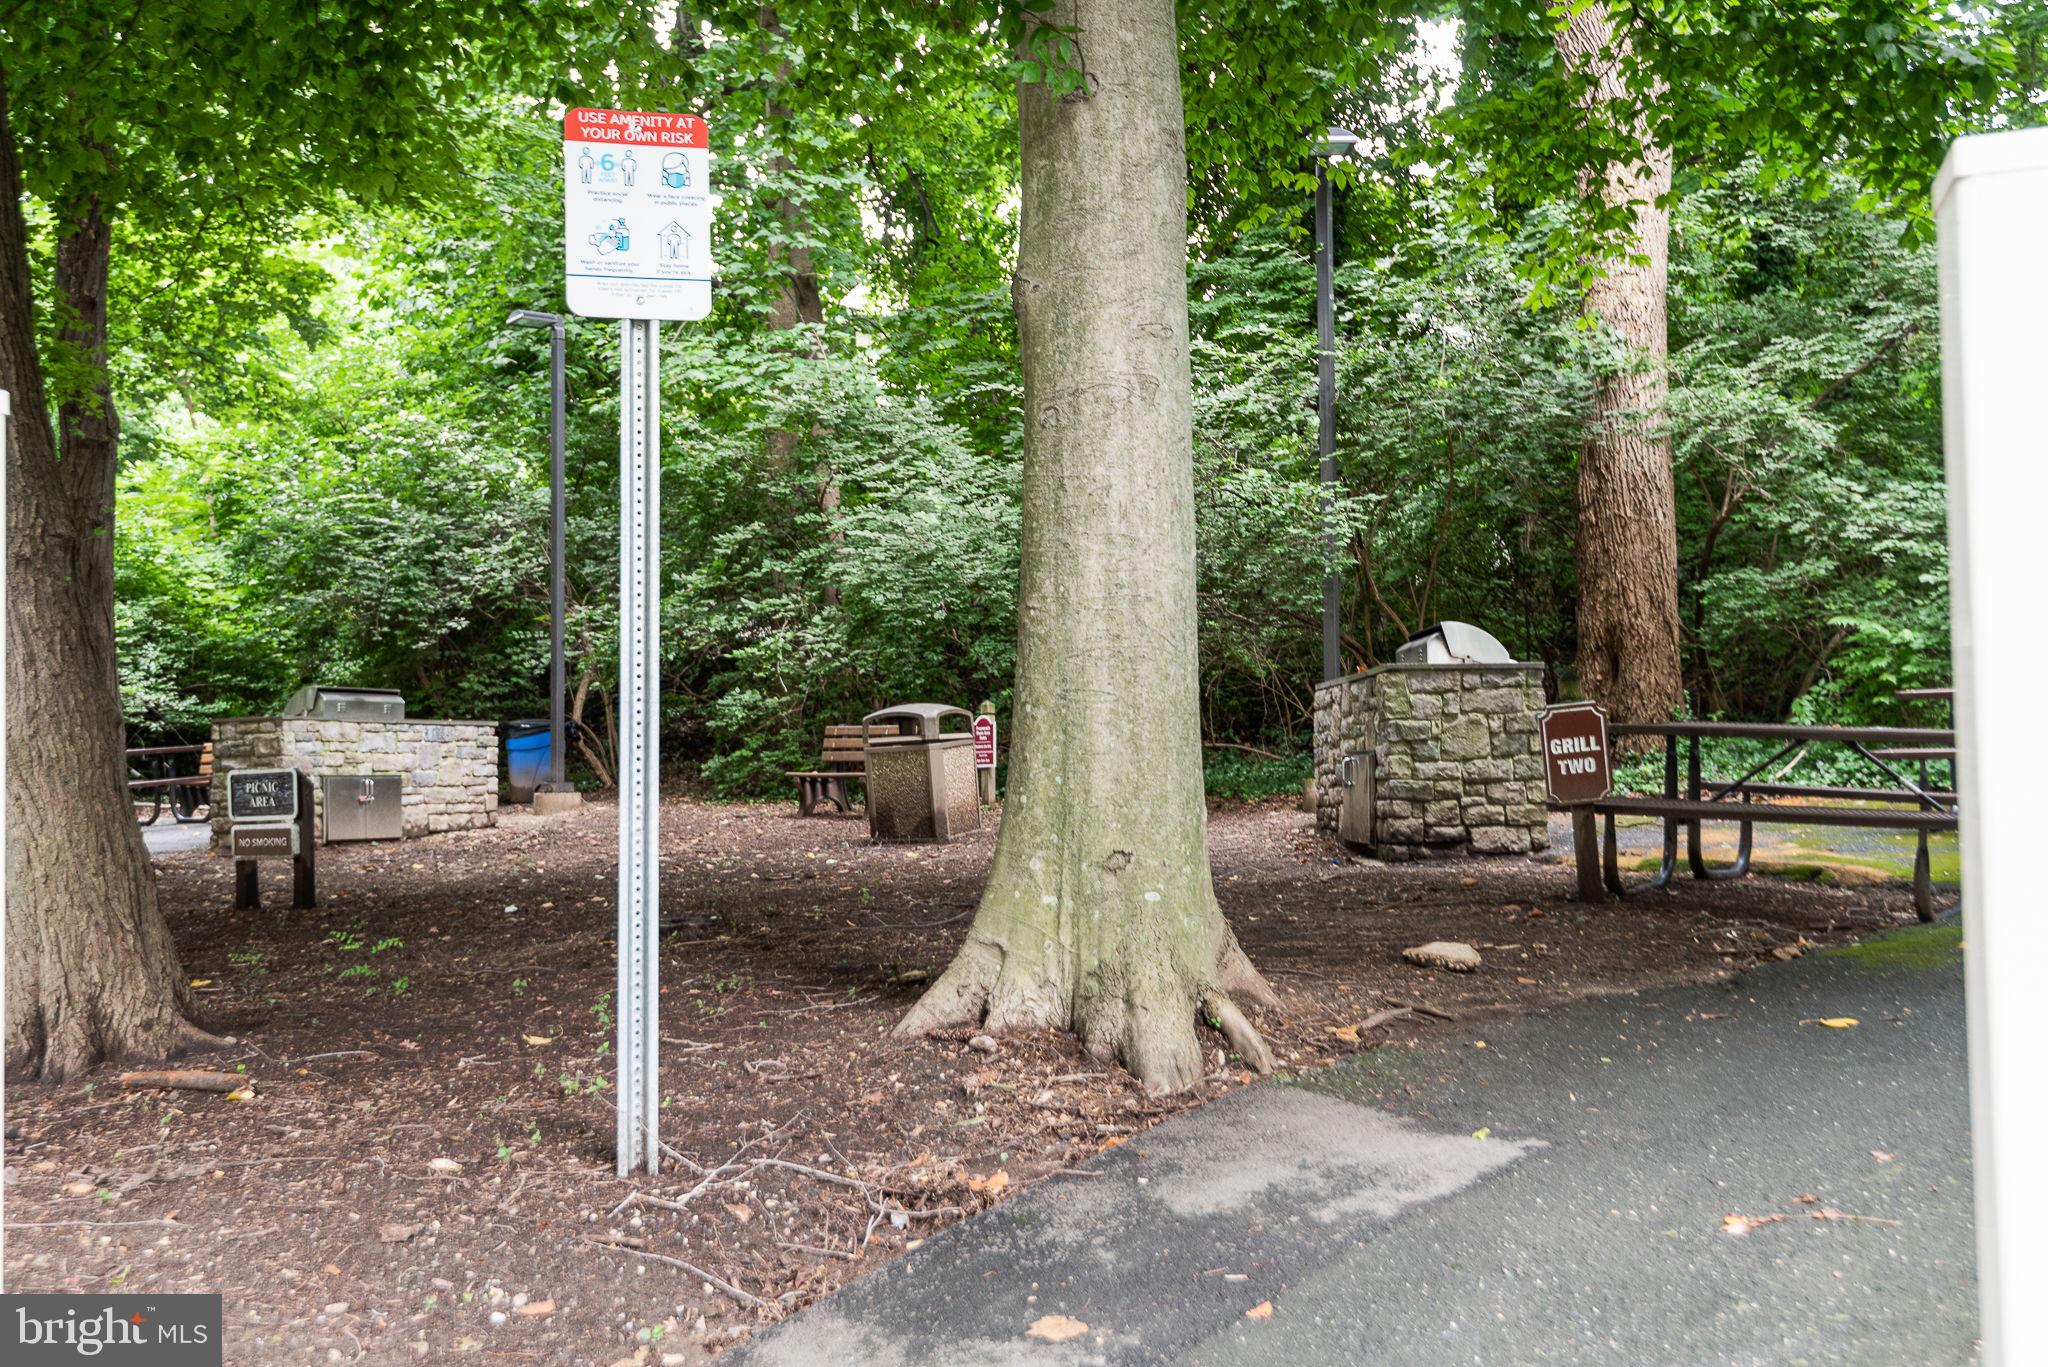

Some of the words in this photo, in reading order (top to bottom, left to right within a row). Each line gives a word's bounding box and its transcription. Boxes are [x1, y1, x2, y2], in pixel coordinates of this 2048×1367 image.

[578, 111, 607, 123] USE
[610, 113, 674, 128] AMENITY
[676, 118, 696, 129] AT
[581, 127, 621, 140] YOUR
[624, 130, 658, 143] OWN
[661, 132, 694, 144] RISK
[600, 153, 615, 171] 6
[1550, 735, 1601, 755] GRILL
[1557, 756, 1597, 776] TWO
[245, 781, 279, 794] PICNIC
[249, 797, 276, 808] AREA
[239, 838, 251, 847] NO
[252, 836, 288, 847] SMOKING
